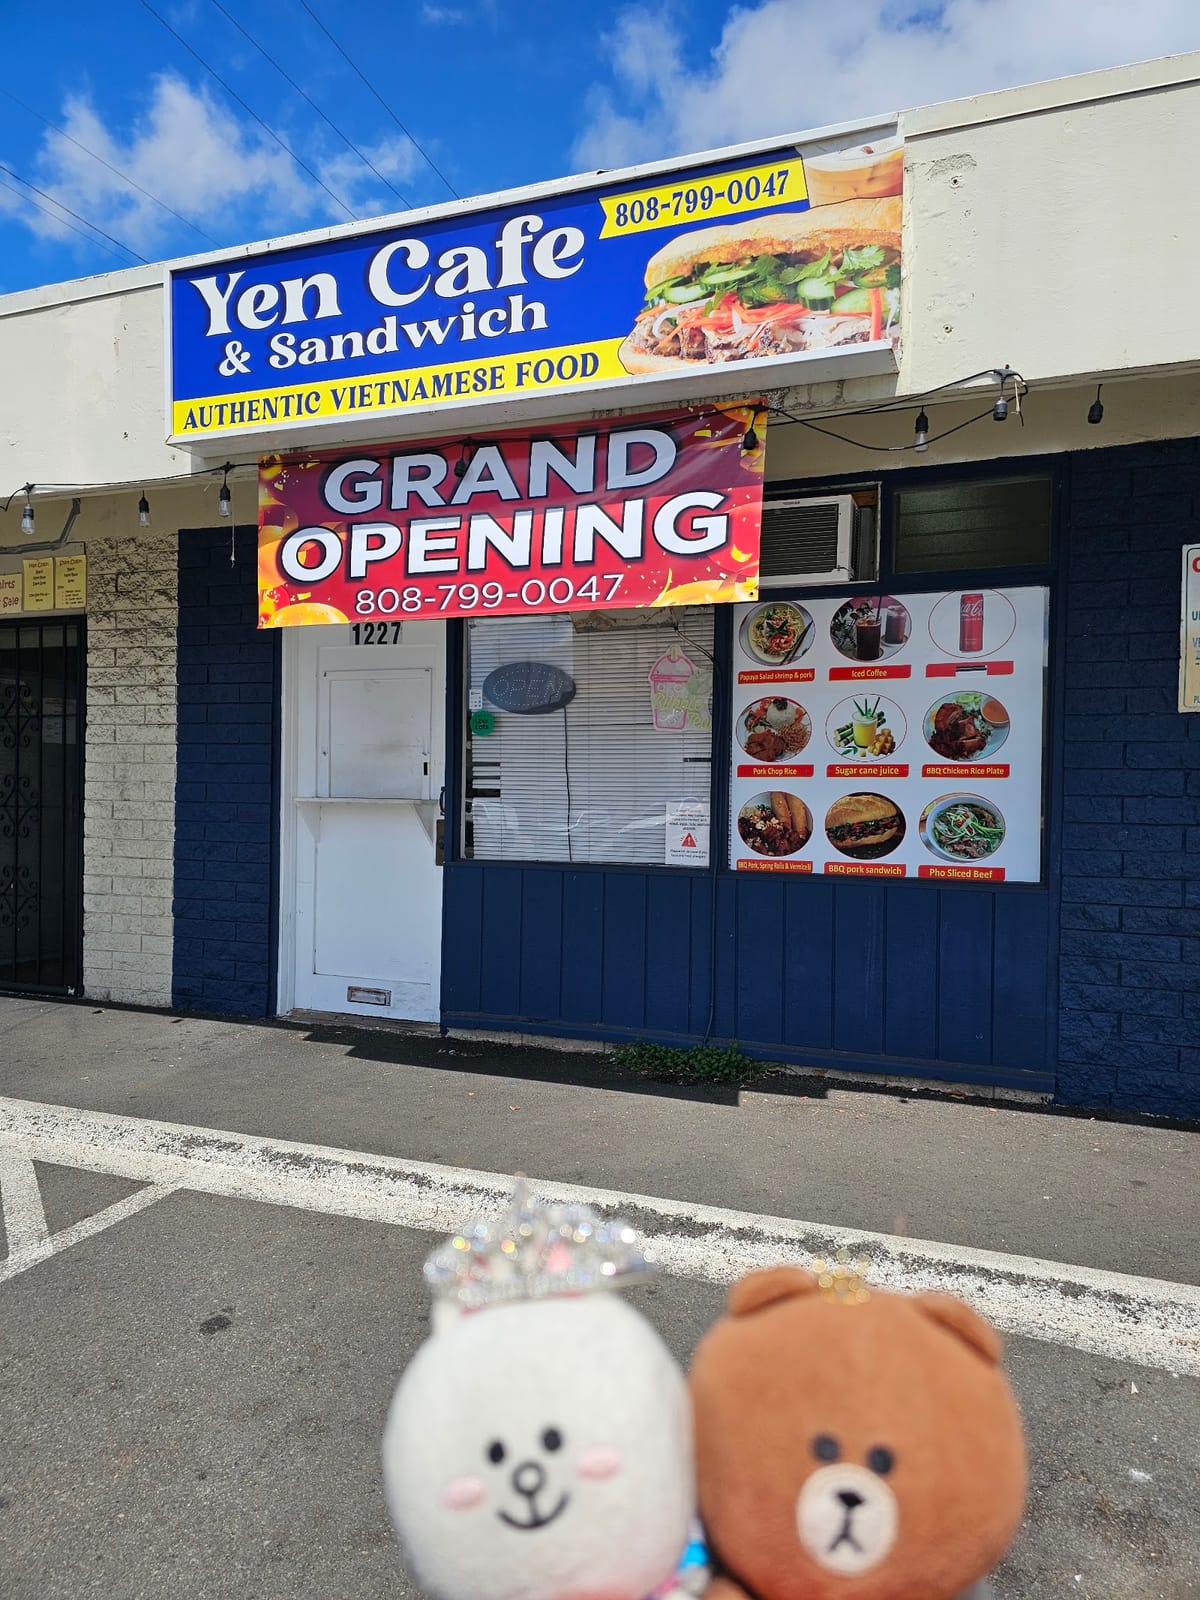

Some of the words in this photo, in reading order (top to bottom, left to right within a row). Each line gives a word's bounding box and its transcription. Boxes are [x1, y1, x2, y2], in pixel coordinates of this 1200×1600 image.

[615, 169, 789, 227] 808-799-0047
[189, 271, 343, 337] Yen
[368, 214, 586, 307] Cafe
[218, 340, 252, 377] &
[269, 294, 549, 370] Sandwich
[183, 391, 321, 431] AUTHENTIC
[330, 365, 505, 410] VIETNAMESE
[516, 352, 599, 386] FOOD
[322, 428, 678, 515] GRAND
[280, 490, 730, 583] OPENING
[355, 573, 625, 615] 808-799-0047
[352, 622, 401, 646] 1227
[760, 672, 774, 680] Salad
[775, 671, 793, 680] shrimp
[800, 671, 813, 680] pork
[866, 668, 887, 677] Coffee
[492, 679, 564, 698] OPEN
[753, 767, 766, 775] Pork
[767, 767, 783, 776] Chop
[784, 767, 797, 775] Rice
[835, 766, 857, 776] Sugar
[859, 767, 878, 775] cane
[879, 766, 899, 776] juice
[926, 767, 941, 775] BBQ
[942, 767, 969, 775] Chicken
[970, 767, 985, 775] Rice
[986, 767, 1004, 775] Plate
[828, 865, 845, 874] BBQ
[846, 865, 864, 874] pork
[865, 866, 902, 875] sandwich
[929, 868, 945, 877] Pho
[947, 868, 971, 878] Sliced
[973, 869, 993, 879] Beef
